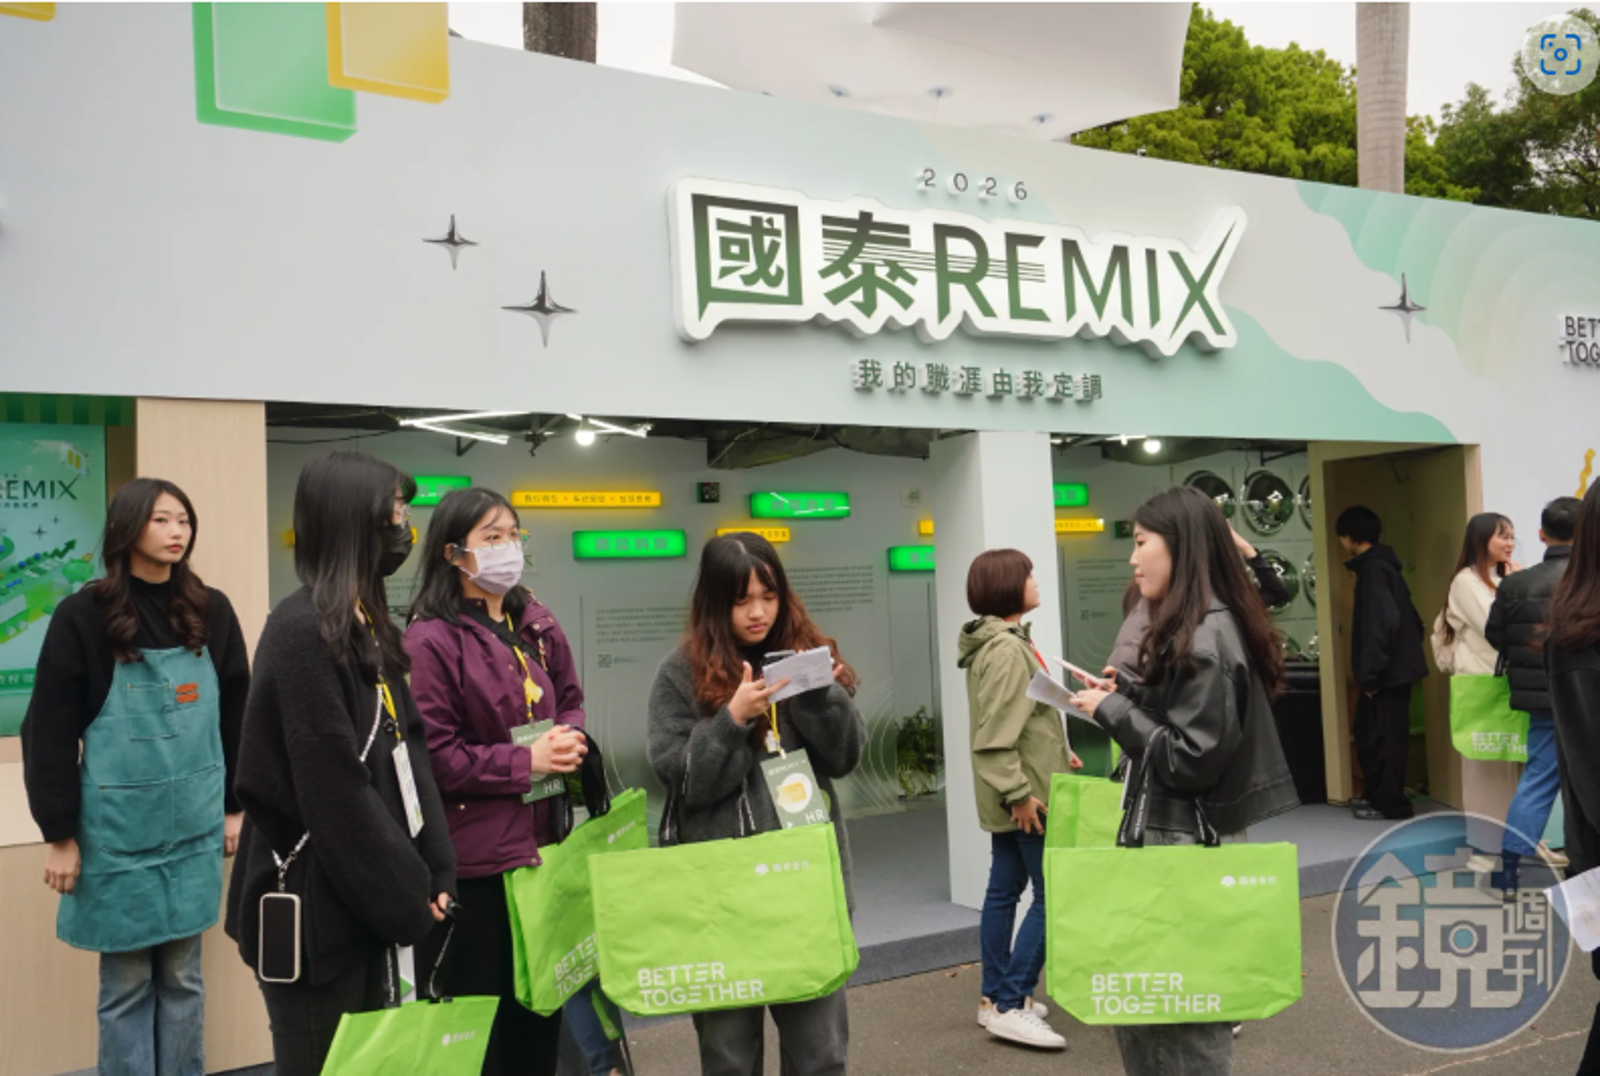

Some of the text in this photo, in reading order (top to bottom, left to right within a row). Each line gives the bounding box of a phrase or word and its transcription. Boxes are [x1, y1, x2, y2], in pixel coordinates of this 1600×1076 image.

[922, 167, 1028, 201] 2026
[857, 358, 1103, 400] 我的職涯由我定調
[0, 473, 77, 501] EMIX
[804, 808, 824, 824] HR
[638, 961, 725, 988] BETTER
[1091, 972, 1184, 993] BETTER
[639, 978, 765, 1007] TOGETHER
[1091, 994, 1222, 1015] TOGETHER
